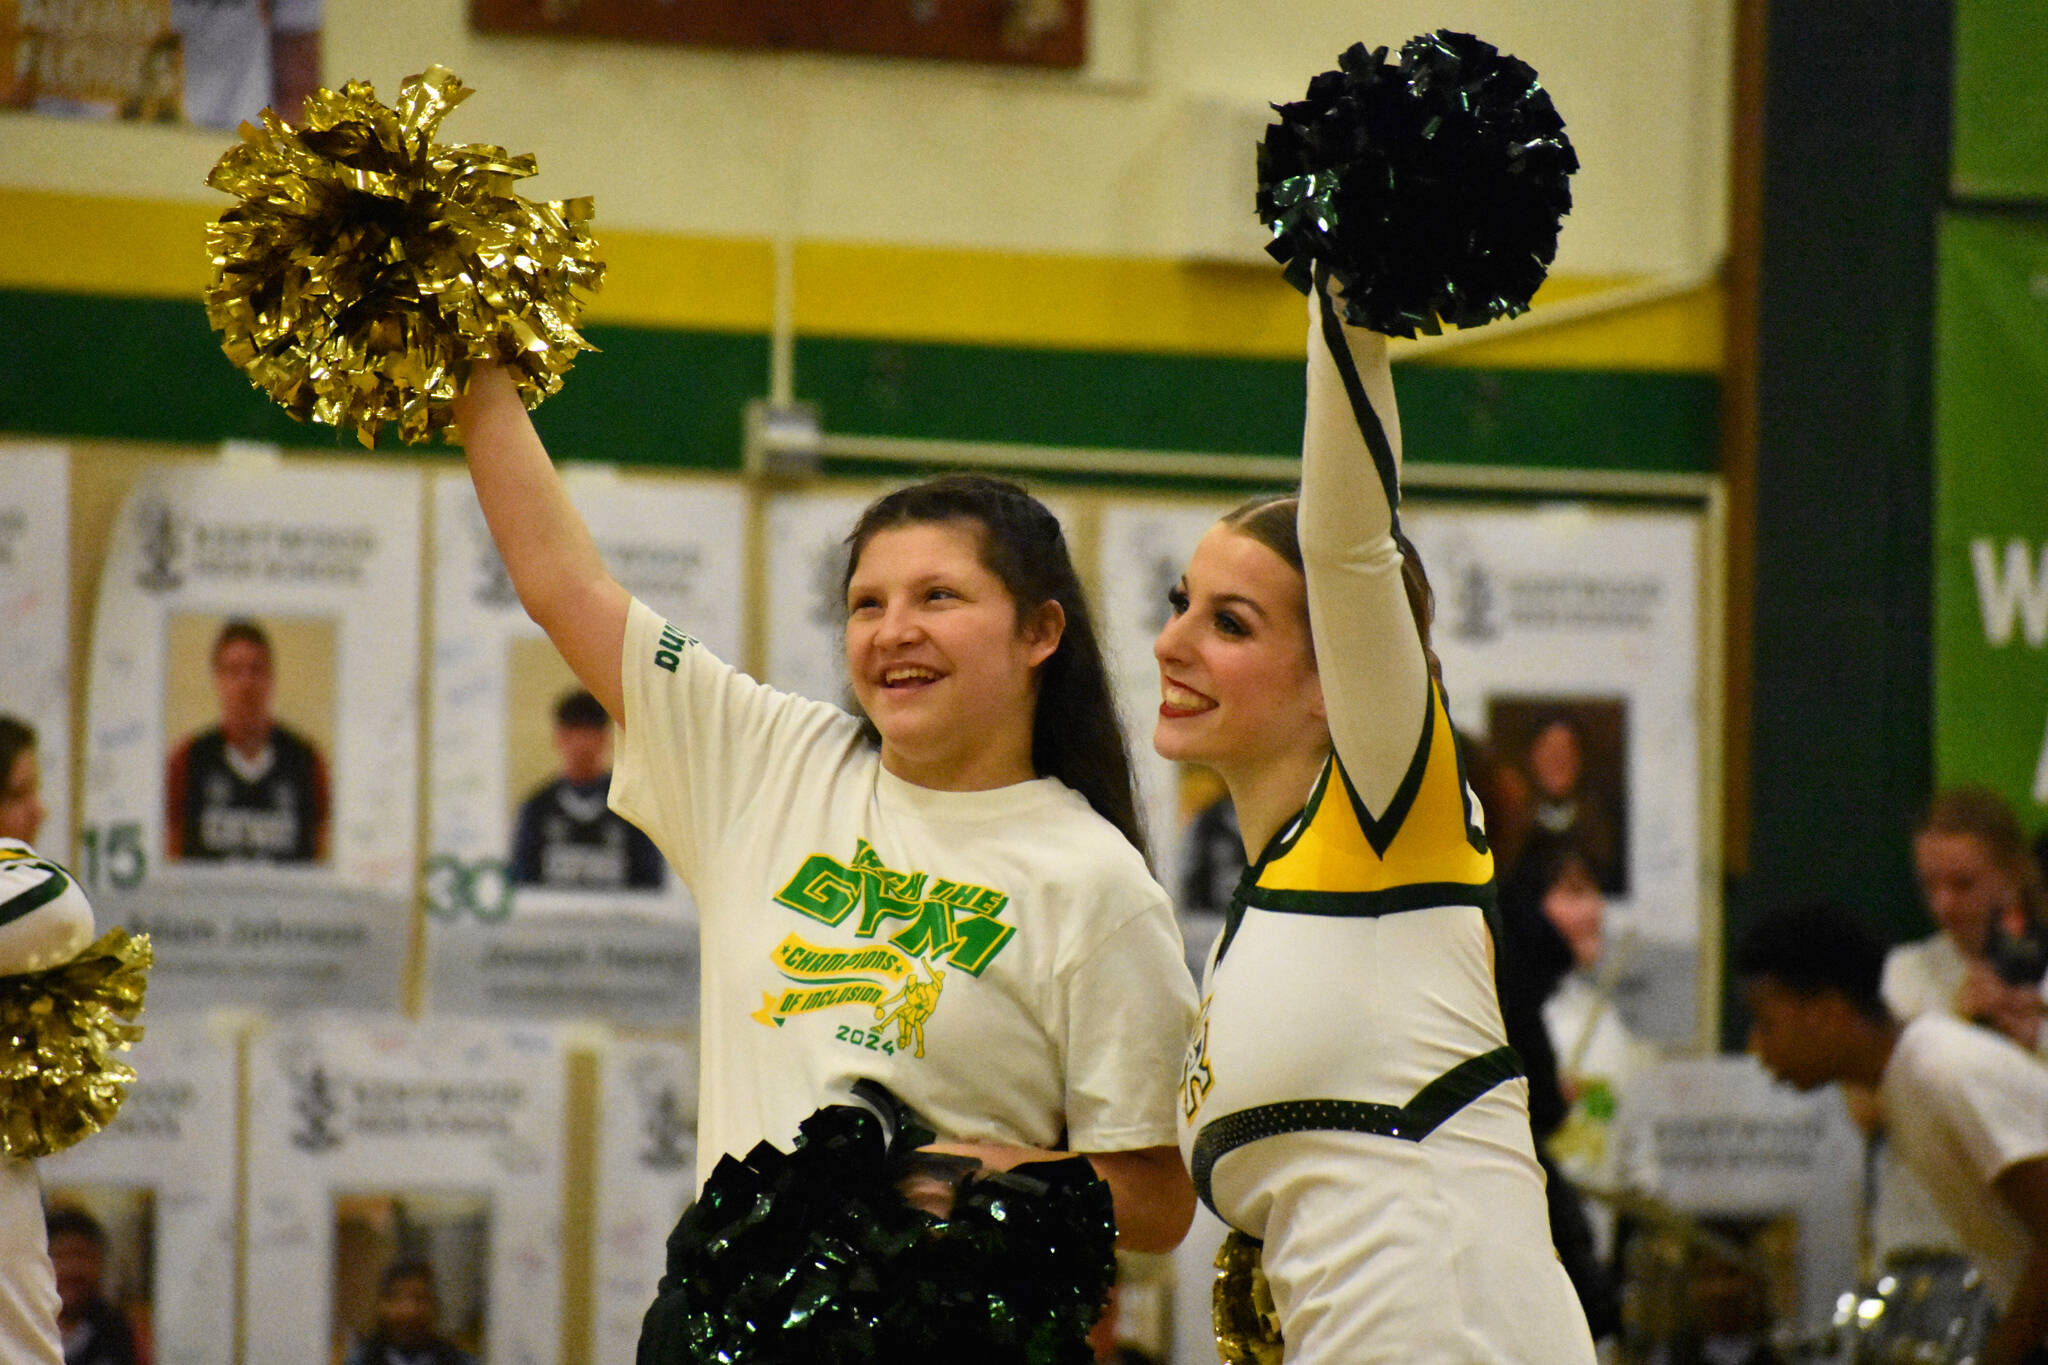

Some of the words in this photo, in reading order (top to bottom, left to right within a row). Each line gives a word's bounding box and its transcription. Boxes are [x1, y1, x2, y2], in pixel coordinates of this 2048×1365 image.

[84, 823, 146, 892] 15
[424, 854, 516, 922] 30
[928, 876, 1009, 919] THE
[772, 853, 1017, 978] GYM
[784, 946, 899, 973] CHAMPIONS
[779, 992, 804, 1012] OF
[800, 986, 883, 1011] INCLUSION
[835, 1025, 895, 1056] 2024
